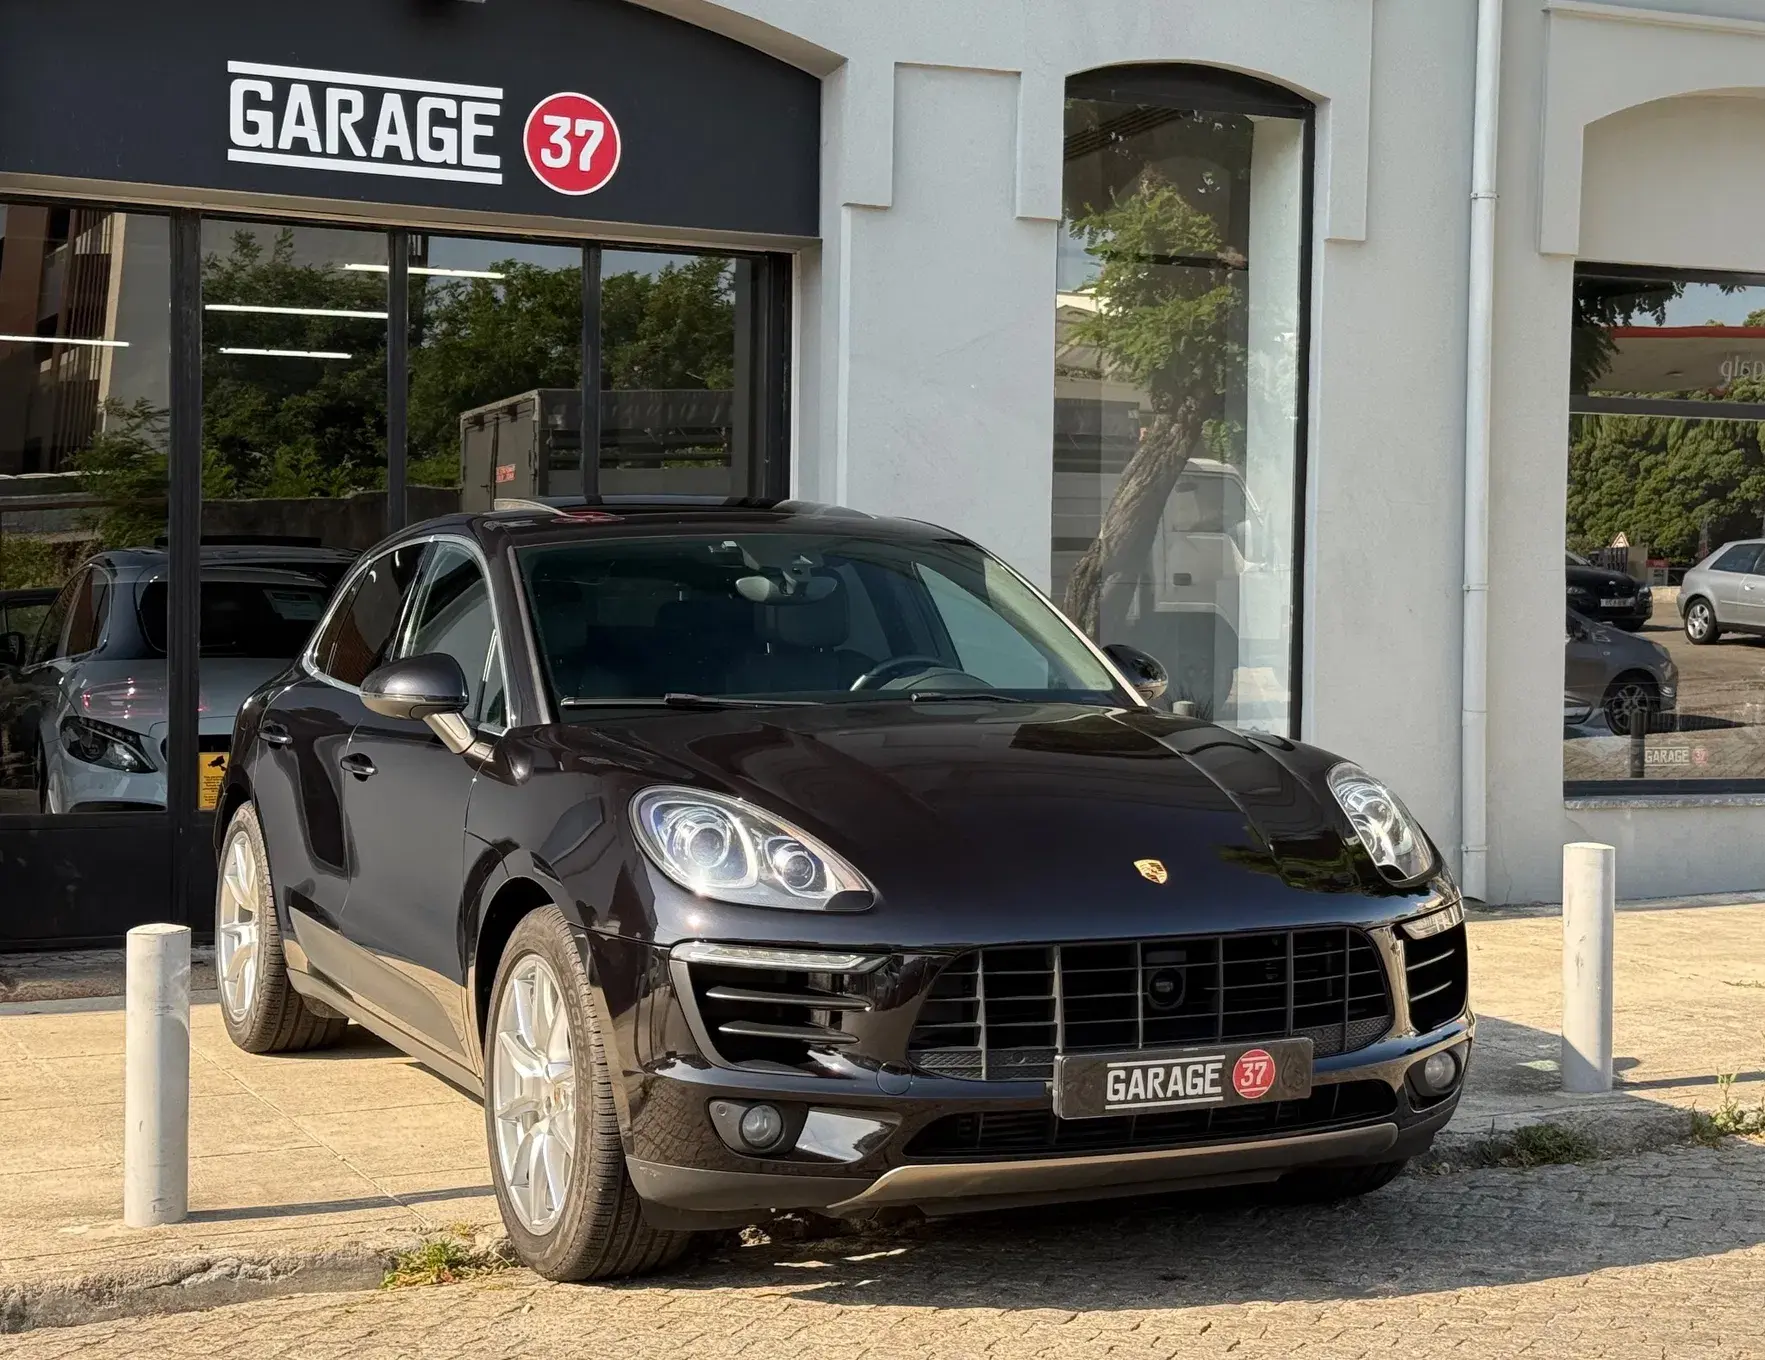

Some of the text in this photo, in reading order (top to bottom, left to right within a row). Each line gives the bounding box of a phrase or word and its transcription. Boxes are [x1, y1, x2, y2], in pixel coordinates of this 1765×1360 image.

[229, 78, 605, 172] GARAGE 37
[1645, 749, 1690, 763] GARAGE
[1106, 1061, 1268, 1101] GARAGE 37
